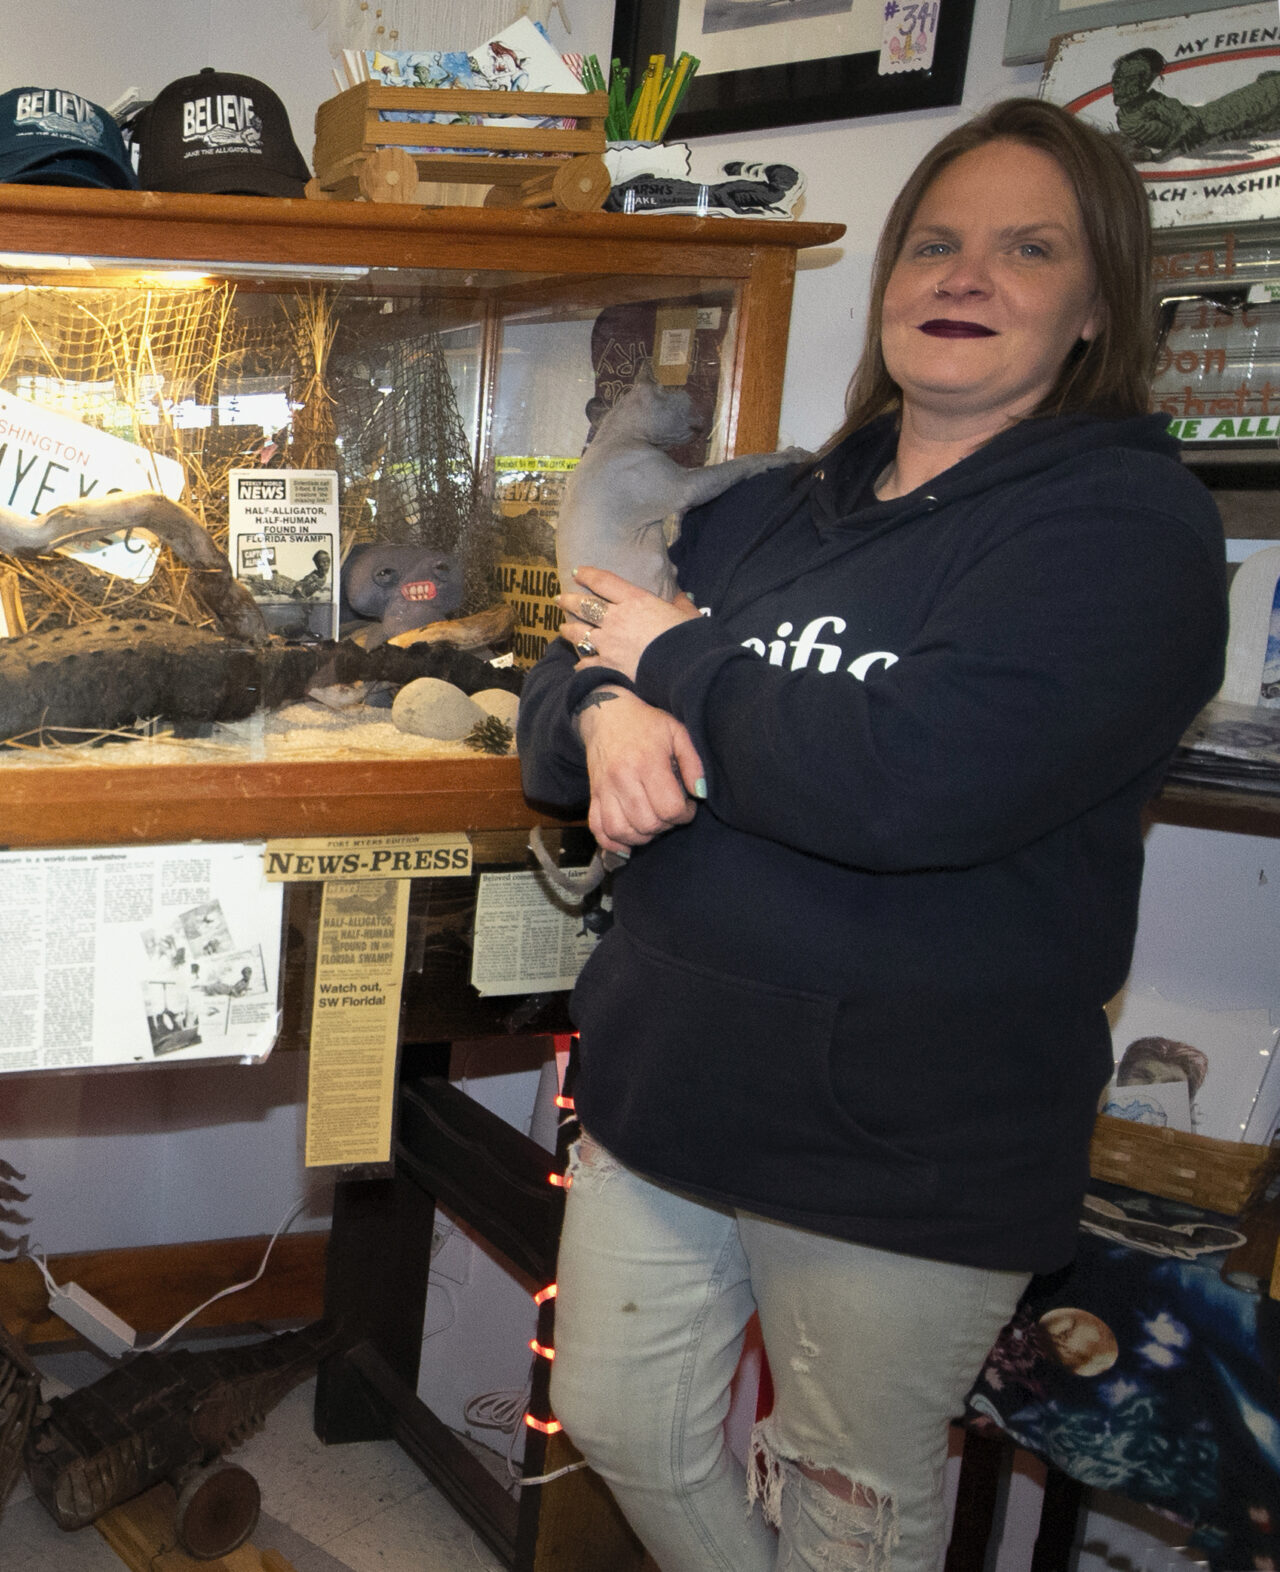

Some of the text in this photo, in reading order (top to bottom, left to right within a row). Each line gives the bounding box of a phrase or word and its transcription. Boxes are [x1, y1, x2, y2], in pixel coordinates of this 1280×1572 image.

[1174, 27, 1280, 57] MY FRIEN
[183, 94, 255, 138] BELIEVE
[183, 150, 200, 159] JAKE
[215, 146, 249, 154] ALLIGATOR
[633, 196, 657, 205] AKE
[1147, 187, 1188, 201] ACH
[1208, 418, 1280, 439] ALL
[240, 486, 284, 499] NEWS
[264, 526, 309, 534] FOUND IN
[246, 535, 327, 543] FLORIDA SWAMP!
[385, 837, 420, 845] EDITION
[266, 849, 469, 875] NEWS-PRESS
[340, 941, 367, 952] FOUND
[370, 941, 380, 952] IN
[321, 952, 393, 965] FLORIDA SWAMP!
[319, 982, 382, 994] Watch out,
[319, 995, 386, 1008] SW Florida!
